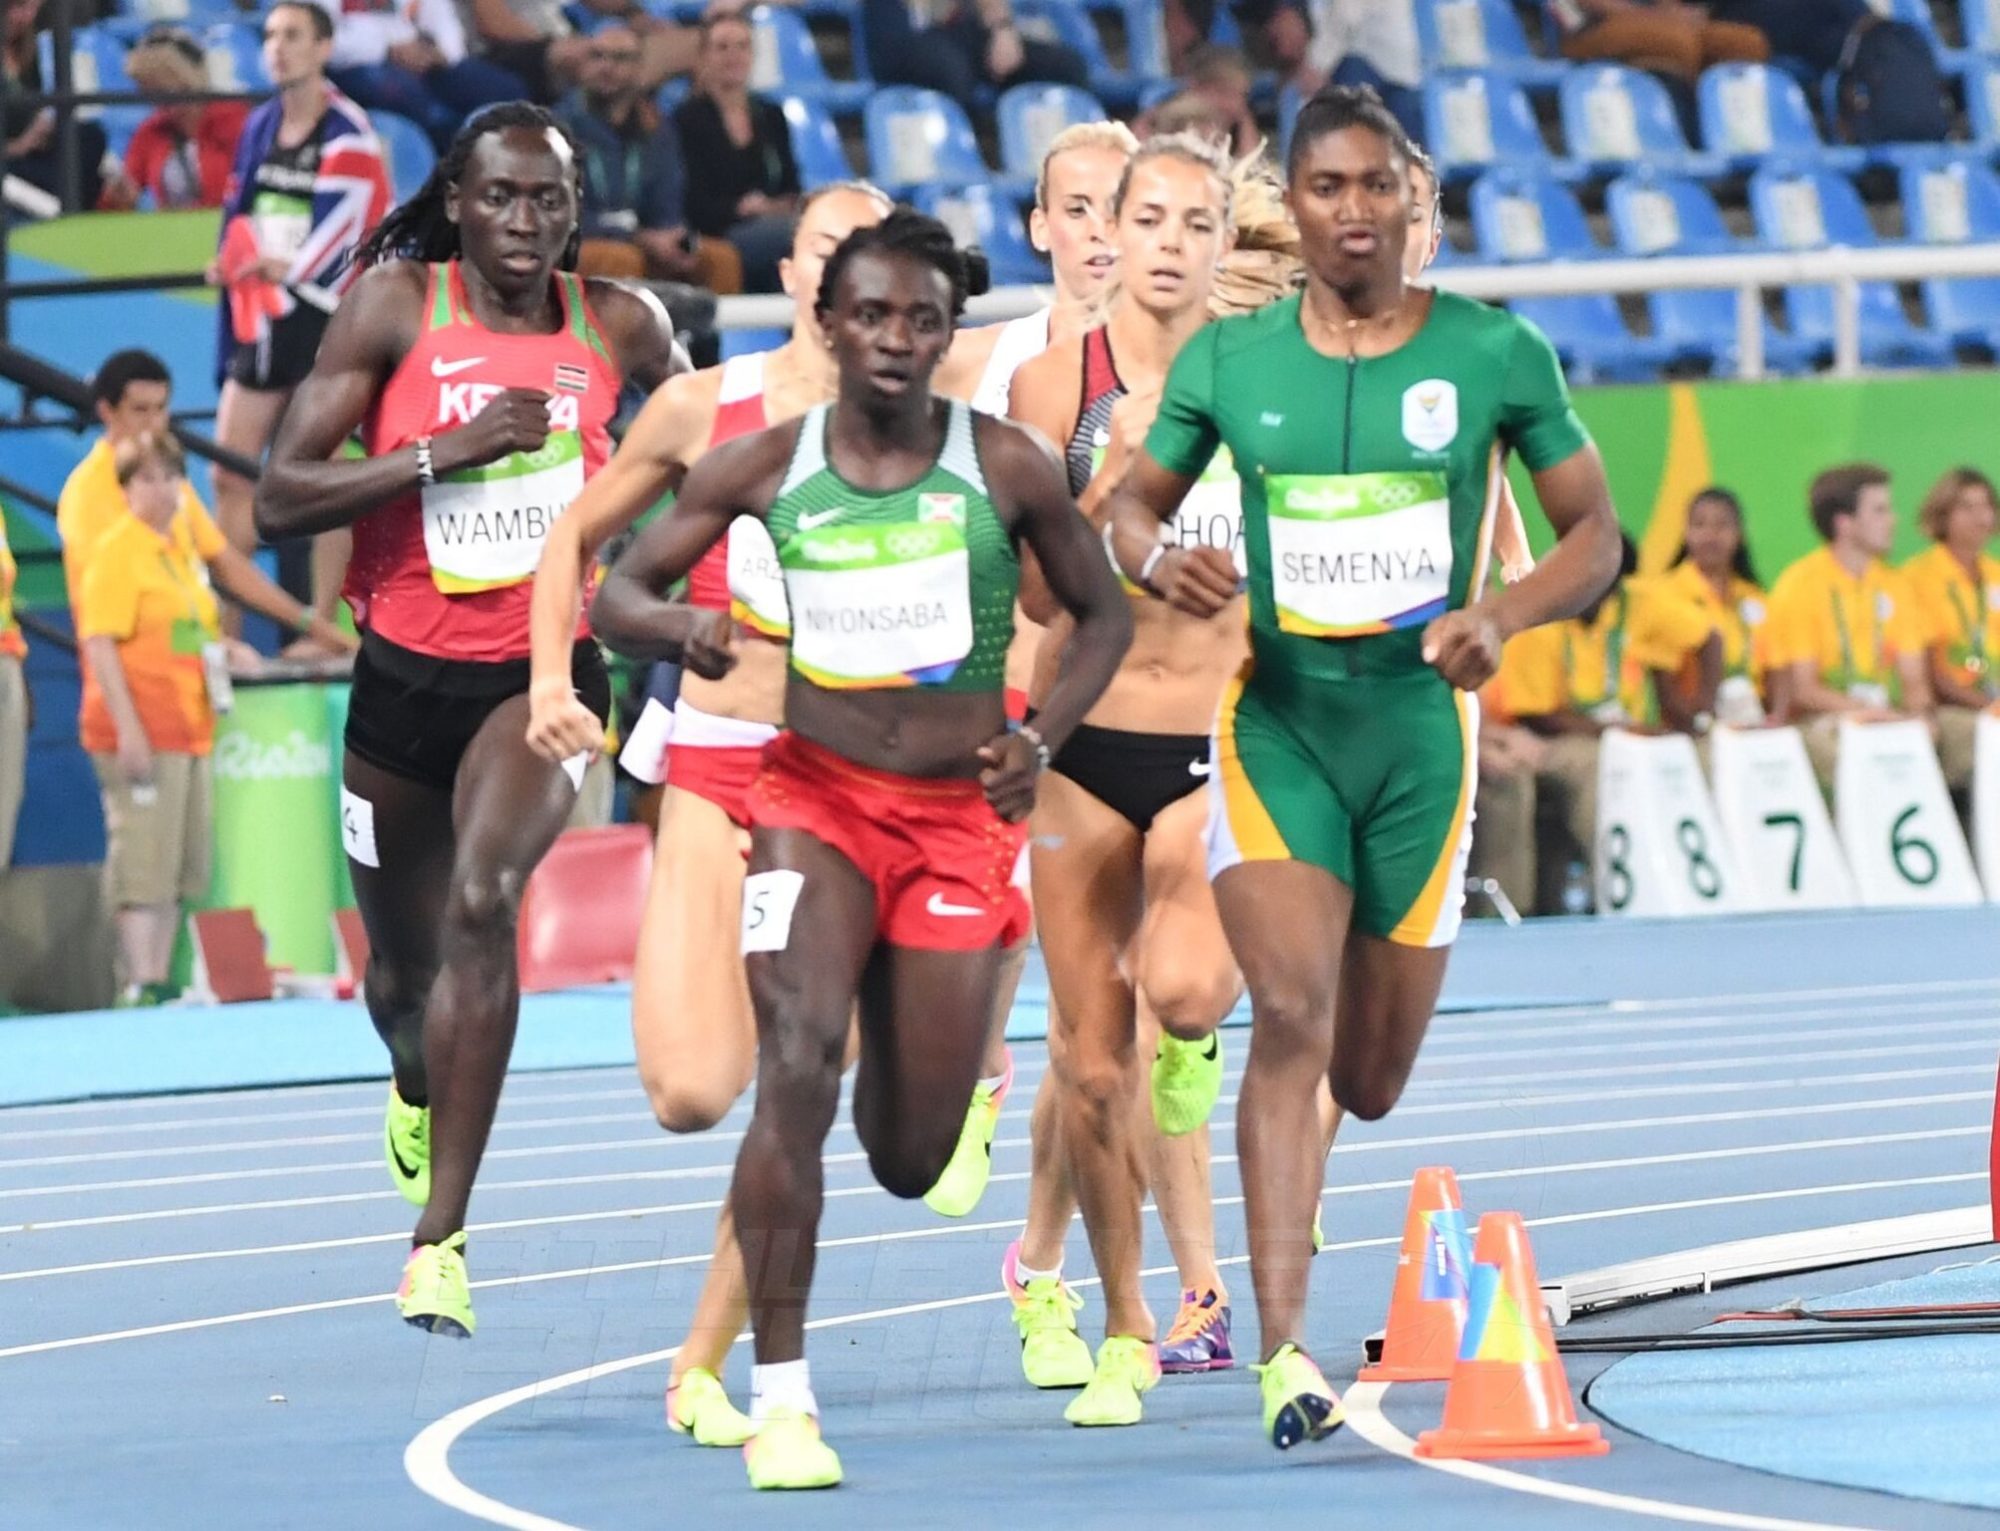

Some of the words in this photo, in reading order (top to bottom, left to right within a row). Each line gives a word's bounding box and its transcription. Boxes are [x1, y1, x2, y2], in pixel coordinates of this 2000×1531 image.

[439, 382, 579, 431] KEA
[1282, 548, 1435, 584] SEMENYA
[805, 602, 948, 633] NIYONSABA
[344, 806, 359, 843] 4
[1890, 803, 1940, 886] 6
[1676, 818, 1722, 899] 8
[1763, 809, 1805, 892] 7
[748, 890, 771, 930] 5
